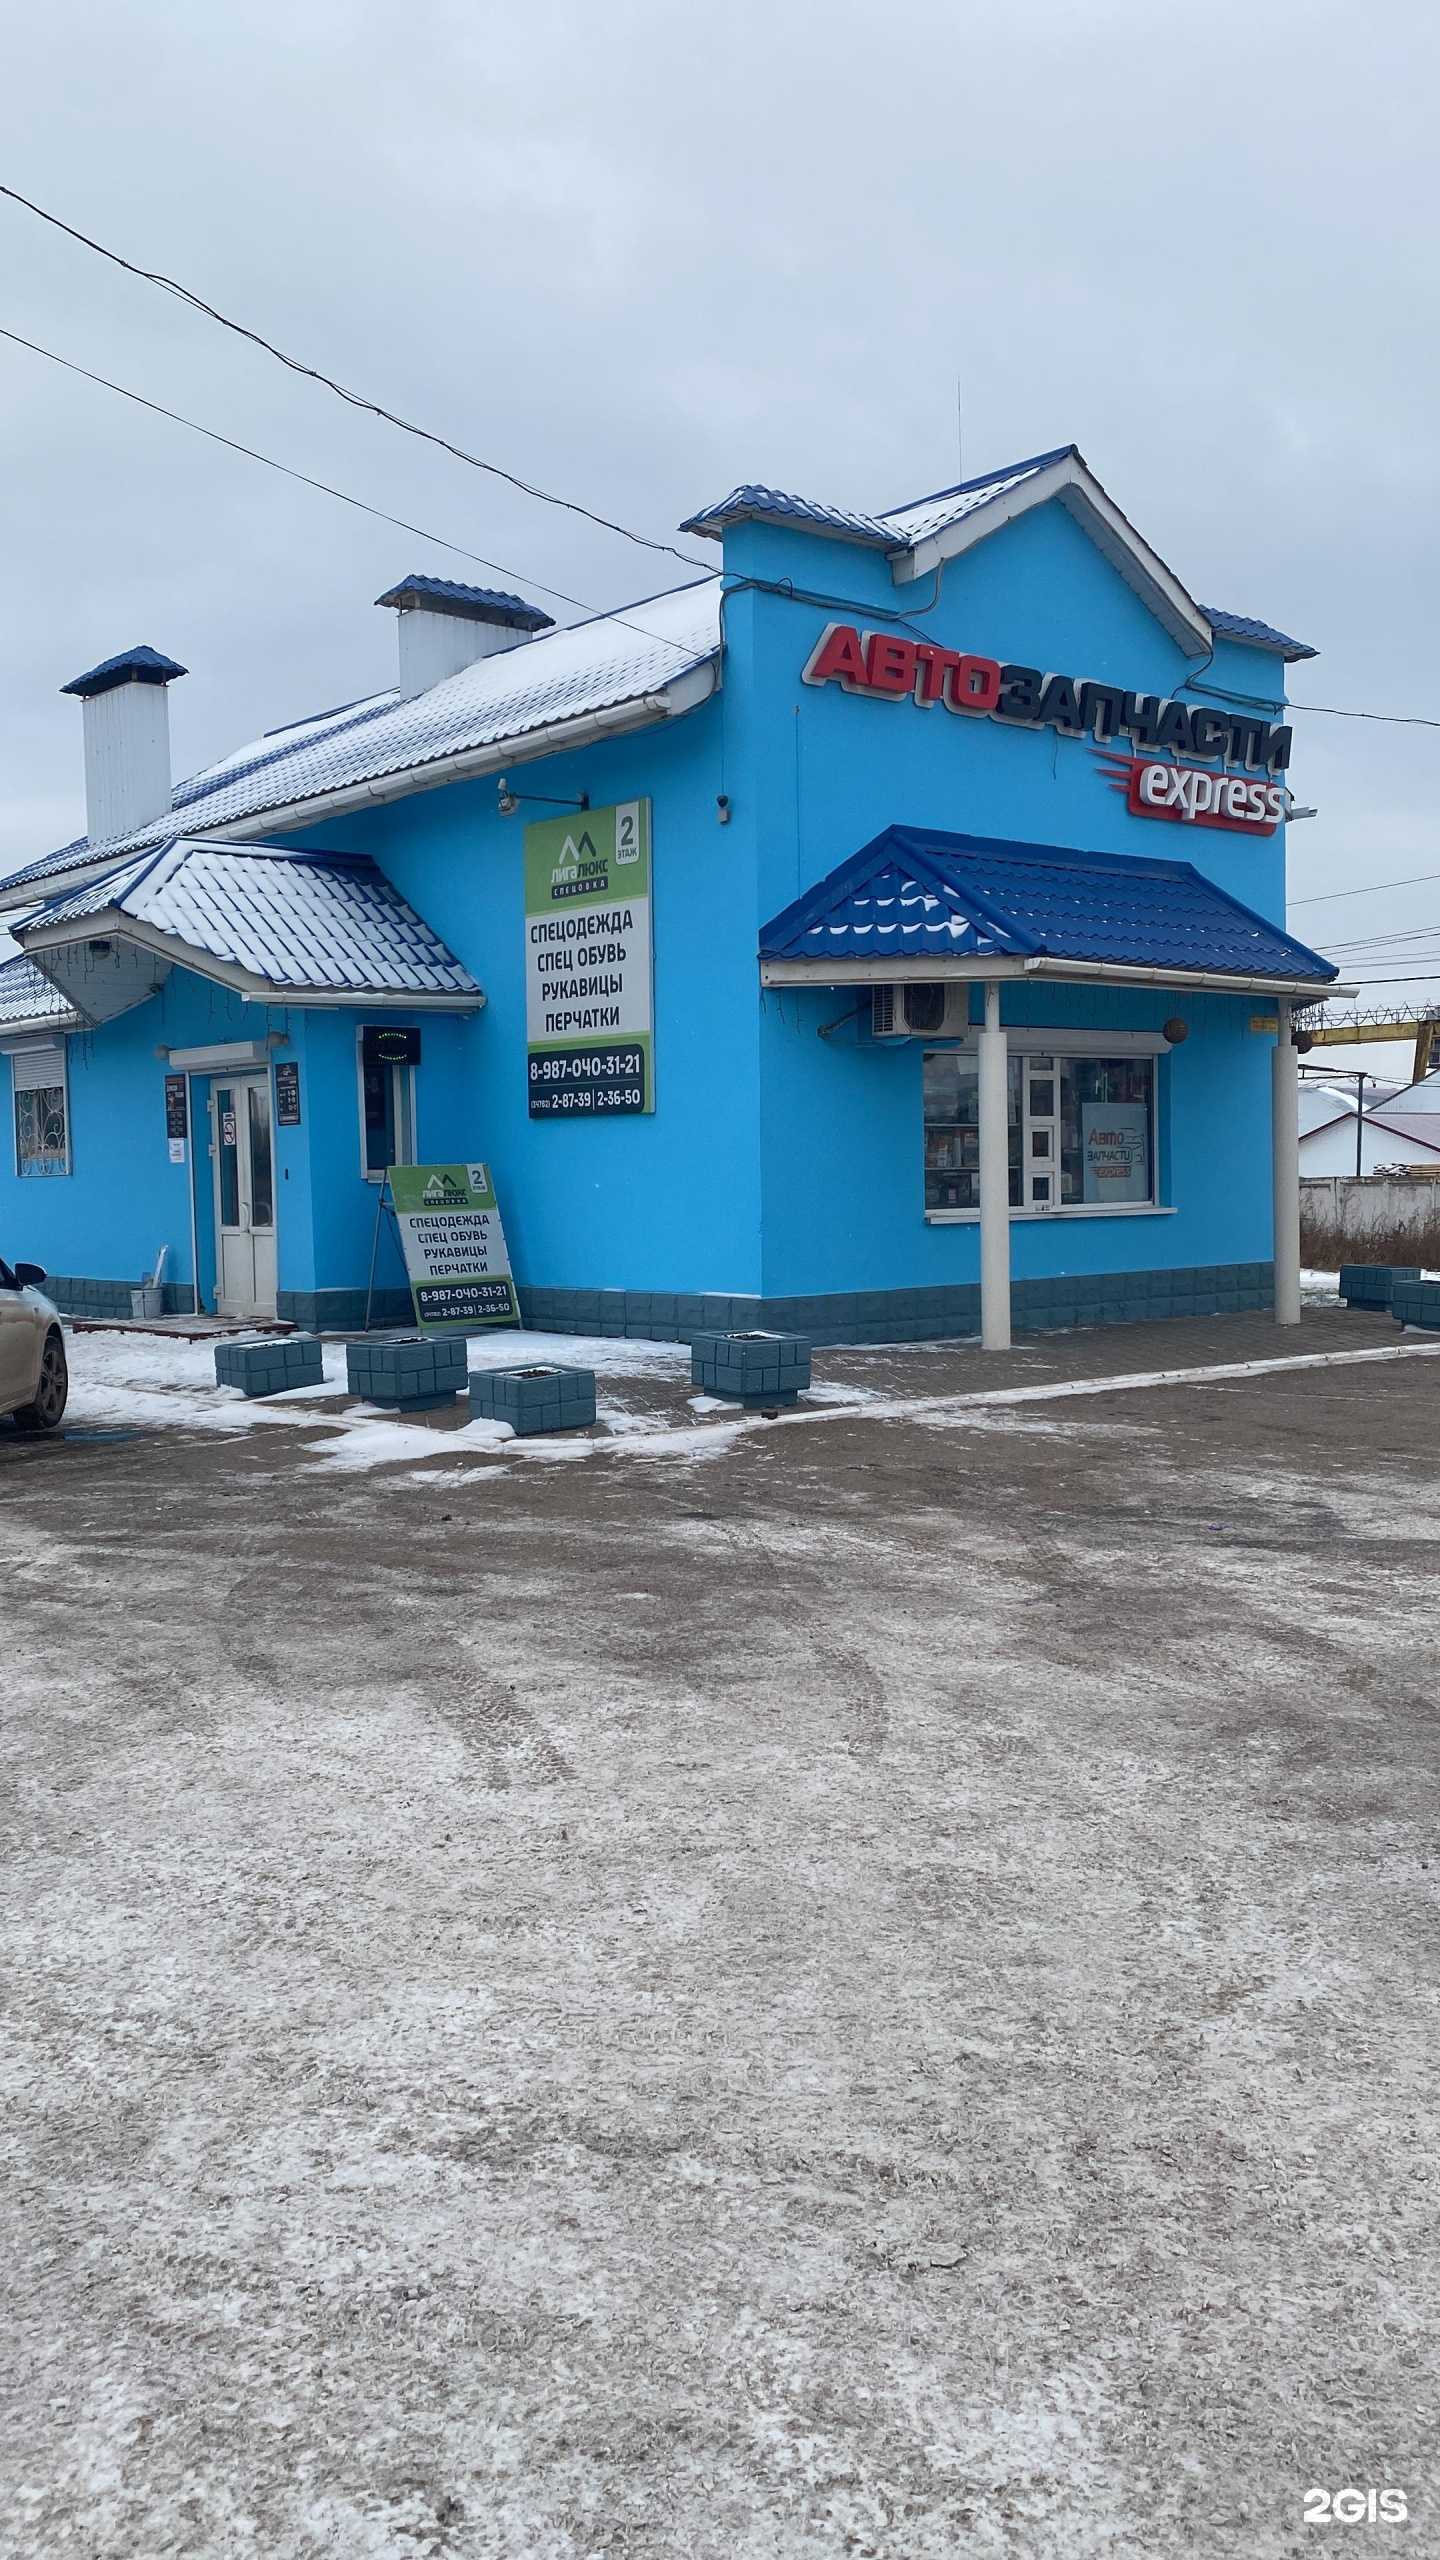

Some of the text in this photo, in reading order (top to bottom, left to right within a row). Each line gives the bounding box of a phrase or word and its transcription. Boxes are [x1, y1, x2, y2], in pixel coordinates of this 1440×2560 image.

[811, 624, 1293, 769] АВТОЗАПЧАСТИ
[1141, 763, 1286, 823] express
[620, 815, 634, 846] 2
[554, 879, 606, 896] СПЕЦОВКА
[530, 909, 634, 944] СПЕЦОДЕЖДА
[537, 942, 627, 972] СПЕЦ ОБУВЬ
[541, 973, 623, 1001] РУКАВИЦЫ
[545, 1006, 620, 1032] ПЕРЧАТКИ
[530, 1054, 640, 1080] 8-987-040-31-21
[551, 1092, 591, 1109] 2-87-39
[597, 1089, 640, 1106] 2-36-50
[472, 1170, 483, 1184] 2
[409, 1214, 490, 1229] СПЕЦОДЕЖДА
[417, 1230, 488, 1244] СПЕЦ ОБУВЬ
[424, 1245, 488, 1260] РУКАВИЦЫ
[429, 1261, 488, 1276] ПЕРЧАТКИ
[420, 1285, 507, 1302] 8-987-040-31-21
